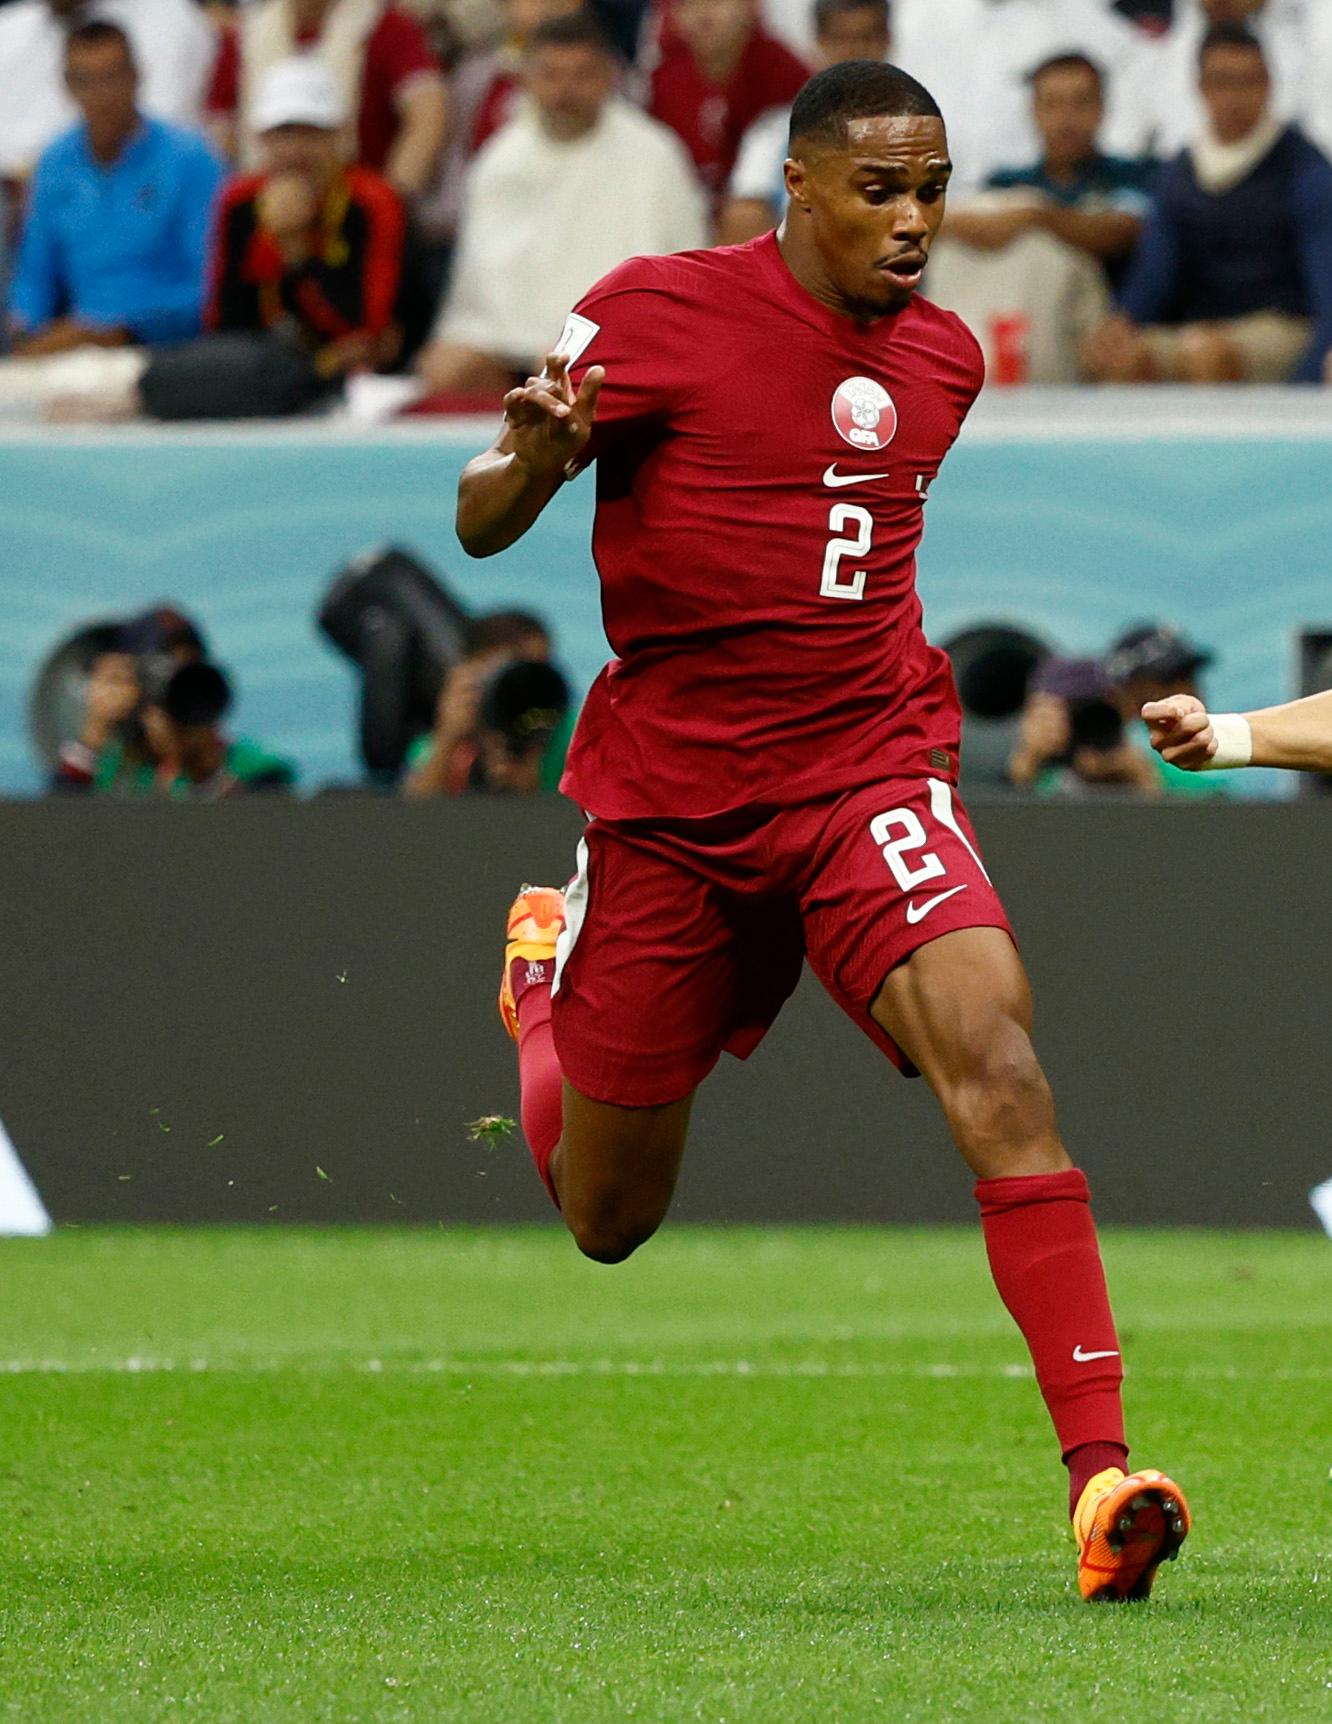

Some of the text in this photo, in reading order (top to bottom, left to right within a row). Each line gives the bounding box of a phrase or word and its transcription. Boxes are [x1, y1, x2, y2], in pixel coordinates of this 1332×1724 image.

[848, 427, 880, 447] QFA
[819, 503, 873, 600] 2
[870, 807, 947, 893] 2
